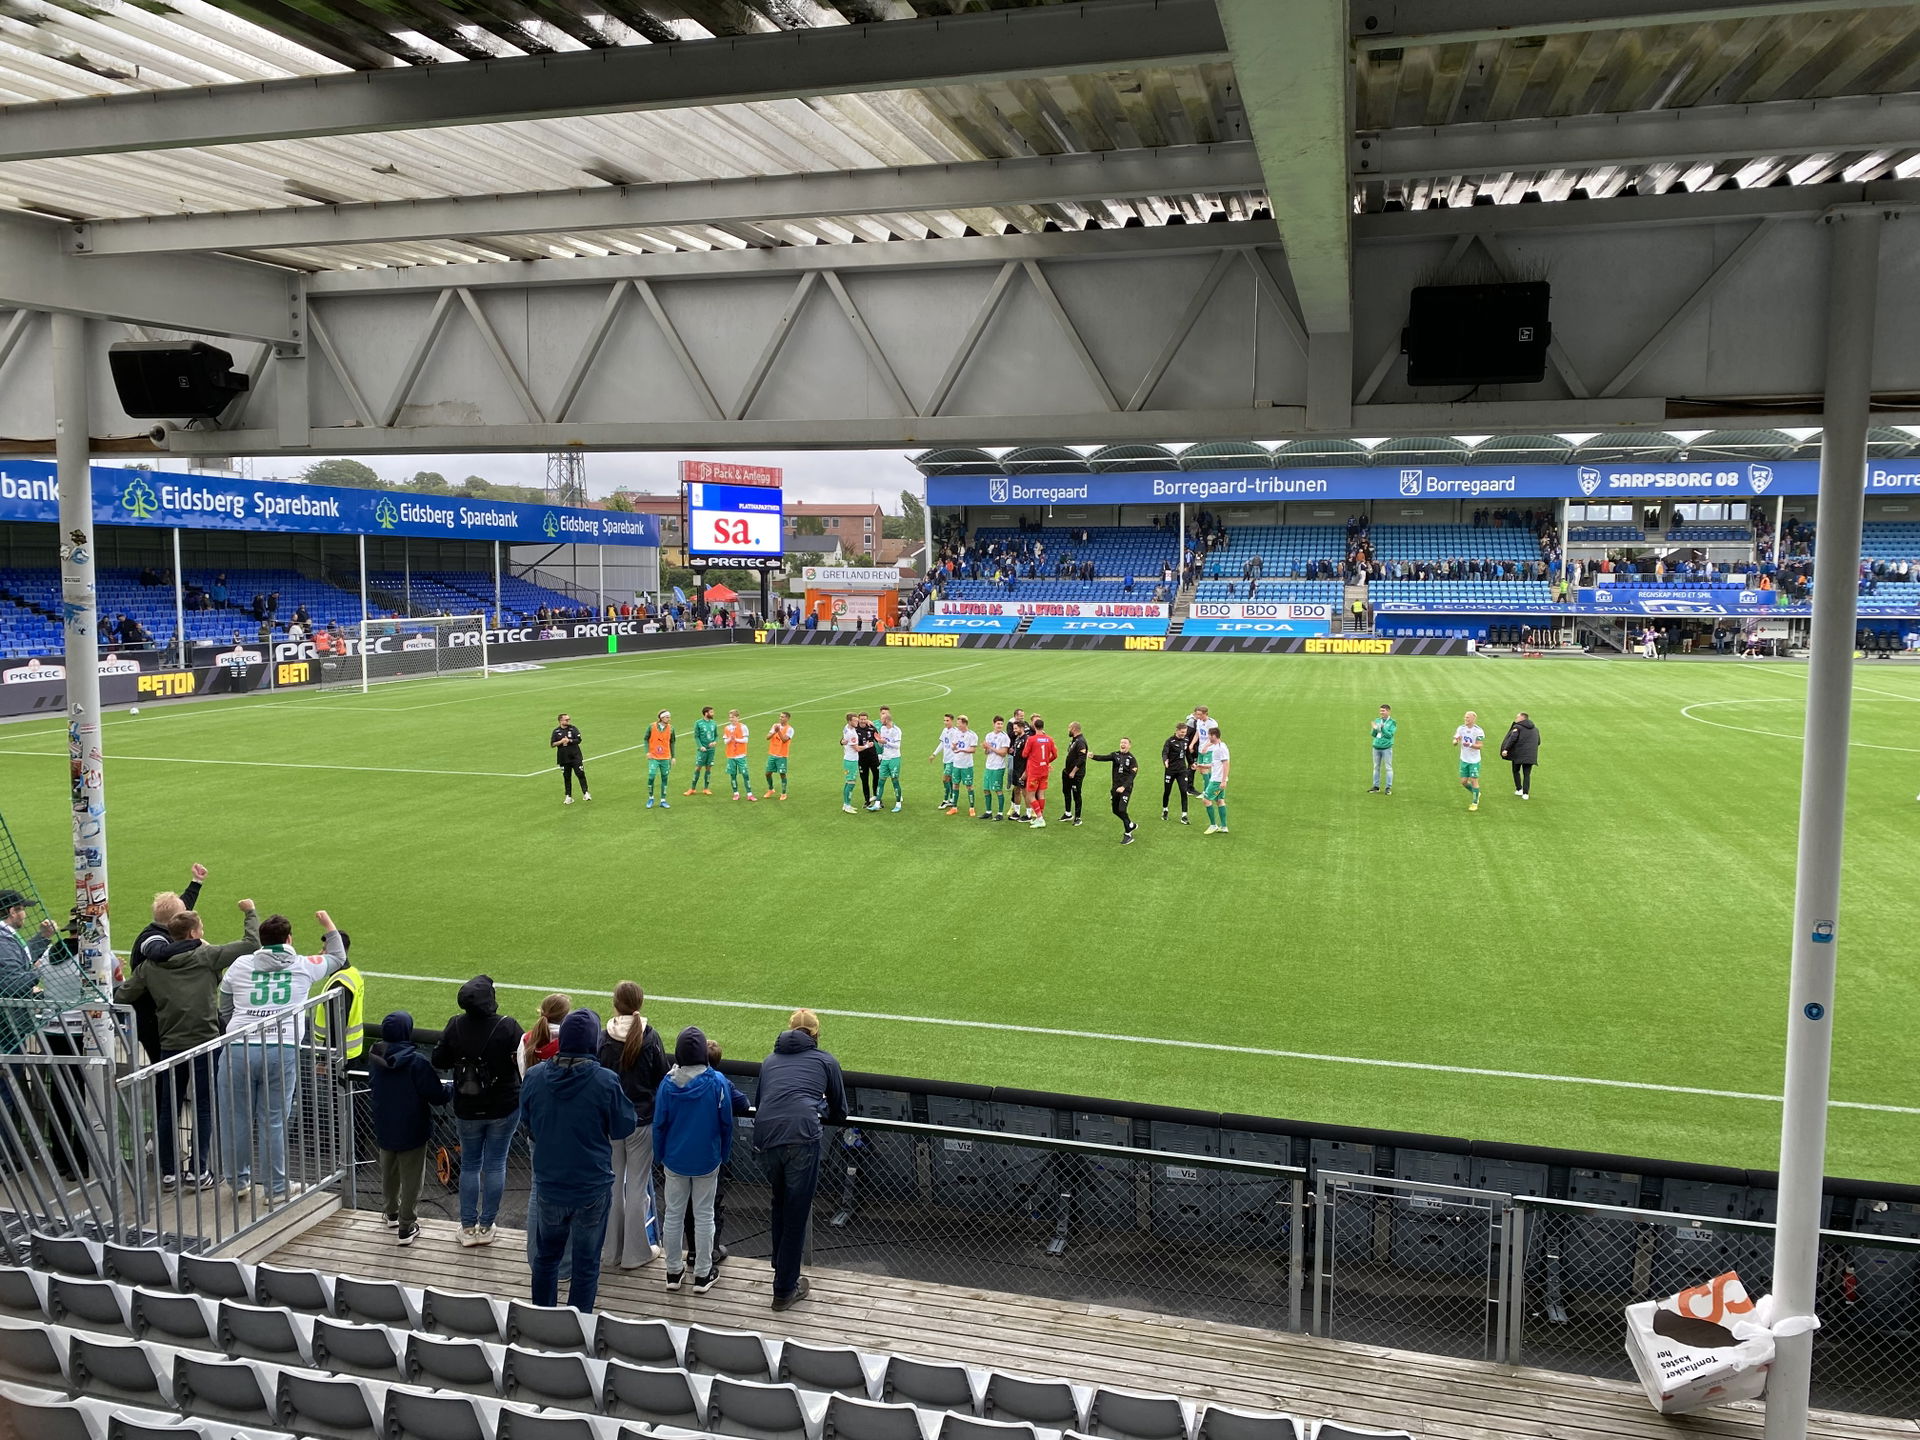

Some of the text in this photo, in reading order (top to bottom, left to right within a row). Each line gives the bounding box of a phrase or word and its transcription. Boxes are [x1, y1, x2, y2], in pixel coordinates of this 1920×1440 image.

[714, 467, 771, 484] Park & Anlegg
[1609, 471, 1739, 488] SARPSBORG 08
[1012, 484, 1088, 501] Borregaard
[1153, 477, 1327, 498] Borregaard-tribunen
[1427, 476, 1516, 495] Borregaard
[162, 486, 340, 518] Eidsberg Sparebank
[400, 502, 519, 529] Eidsberg Sparebank
[560, 516, 645, 536] Eidsberg Sparebank
[708, 557, 765, 567] PRETEC
[822, 570, 870, 580] GRETLAND
[872, 571, 897, 580] RENO
[1199, 604, 1231, 616] BDO
[1246, 605, 1278, 616] BDO
[1293, 605, 1326, 617] BDO
[574, 622, 638, 639] PRETEC
[931, 619, 1002, 628] IPOA
[1061, 621, 1136, 631] IPOA
[1215, 623, 1295, 632] IPOA
[448, 628, 533, 648] PRETEC
[885, 633, 960, 648] BETONMAST
[1304, 638, 1394, 654] BETONMAST
[275, 637, 392, 662] PRTEC
[10, 670, 60, 681] PRETEC
[98, 664, 135, 674] RETEC
[249, 970, 292, 1006] 33
[1656, 1350, 1673, 1359] her
[1660, 1355, 1692, 1369] kastes
[1666, 1355, 1719, 1379] Tomflasker
